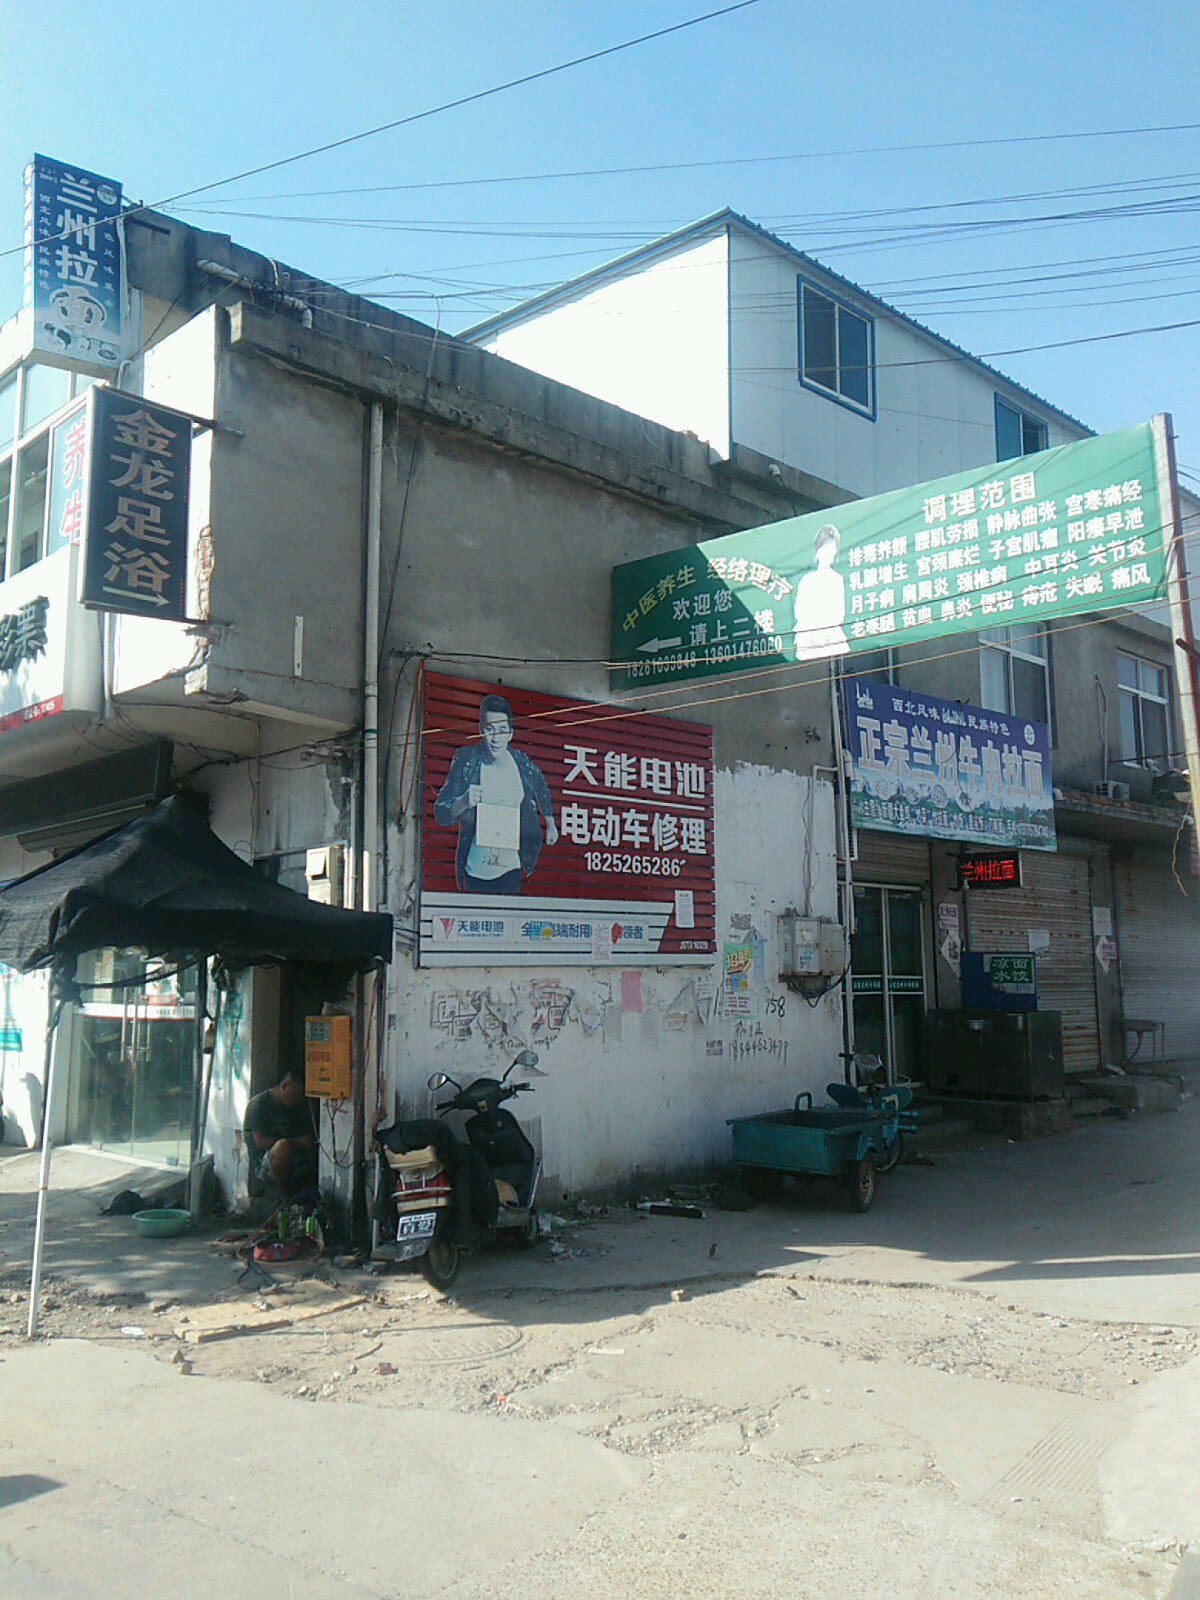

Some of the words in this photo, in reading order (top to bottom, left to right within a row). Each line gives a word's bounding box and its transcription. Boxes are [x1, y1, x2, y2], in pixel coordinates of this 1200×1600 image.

[103, 409, 176, 593] 金龙足浴
[848, 535, 908, 567] 排毒养颜
[914, 518, 979, 552] 腰肌劳损
[987, 500, 1058, 535] 静脉曲张
[1065, 479, 1143, 517] 宫寒痛经
[922, 471, 1036, 524] 调理范围
[848, 560, 909, 592] 乳腺增生
[916, 543, 981, 576] 宫颈糜烂
[989, 527, 1059, 561] 子宫肌瘤
[1067, 506, 1145, 544] 阳痿早泄
[850, 588, 894, 615] 月子病
[902, 576, 949, 604] 肩周炎
[956, 564, 1008, 593] 颈椎病
[1024, 549, 1079, 580] 中耳炎
[1088, 535, 1147, 568] 关节炎
[622, 565, 697, 632] 中医养生
[706, 556, 793, 601] 经络理疗
[672, 589, 733, 621] 欢迎您
[851, 612, 896, 638] 老寒腿
[902, 605, 933, 628] 贫血
[941, 597, 973, 622] 鼻炎
[980, 589, 1015, 614] 便秘
[1021, 581, 1058, 607] 痔疮
[1065, 573, 1104, 599] 失眠
[1111, 562, 1152, 590] 痛风
[689, 608, 775, 647] 请上二楼
[892, 697, 940, 721] 西北风味
[967, 714, 1011, 737] 民族特色
[563, 744, 706, 799] 天能电池
[856, 715, 1043, 801] 正宗兰州牛肉拉面
[561, 802, 707, 855] 电动车修理
[584, 851, 686, 877] 1825265286
[960, 860, 1015, 882] 兰州拉面
[457, 919, 505, 934] 天能电池
[993, 970, 1029, 982] 水饺
